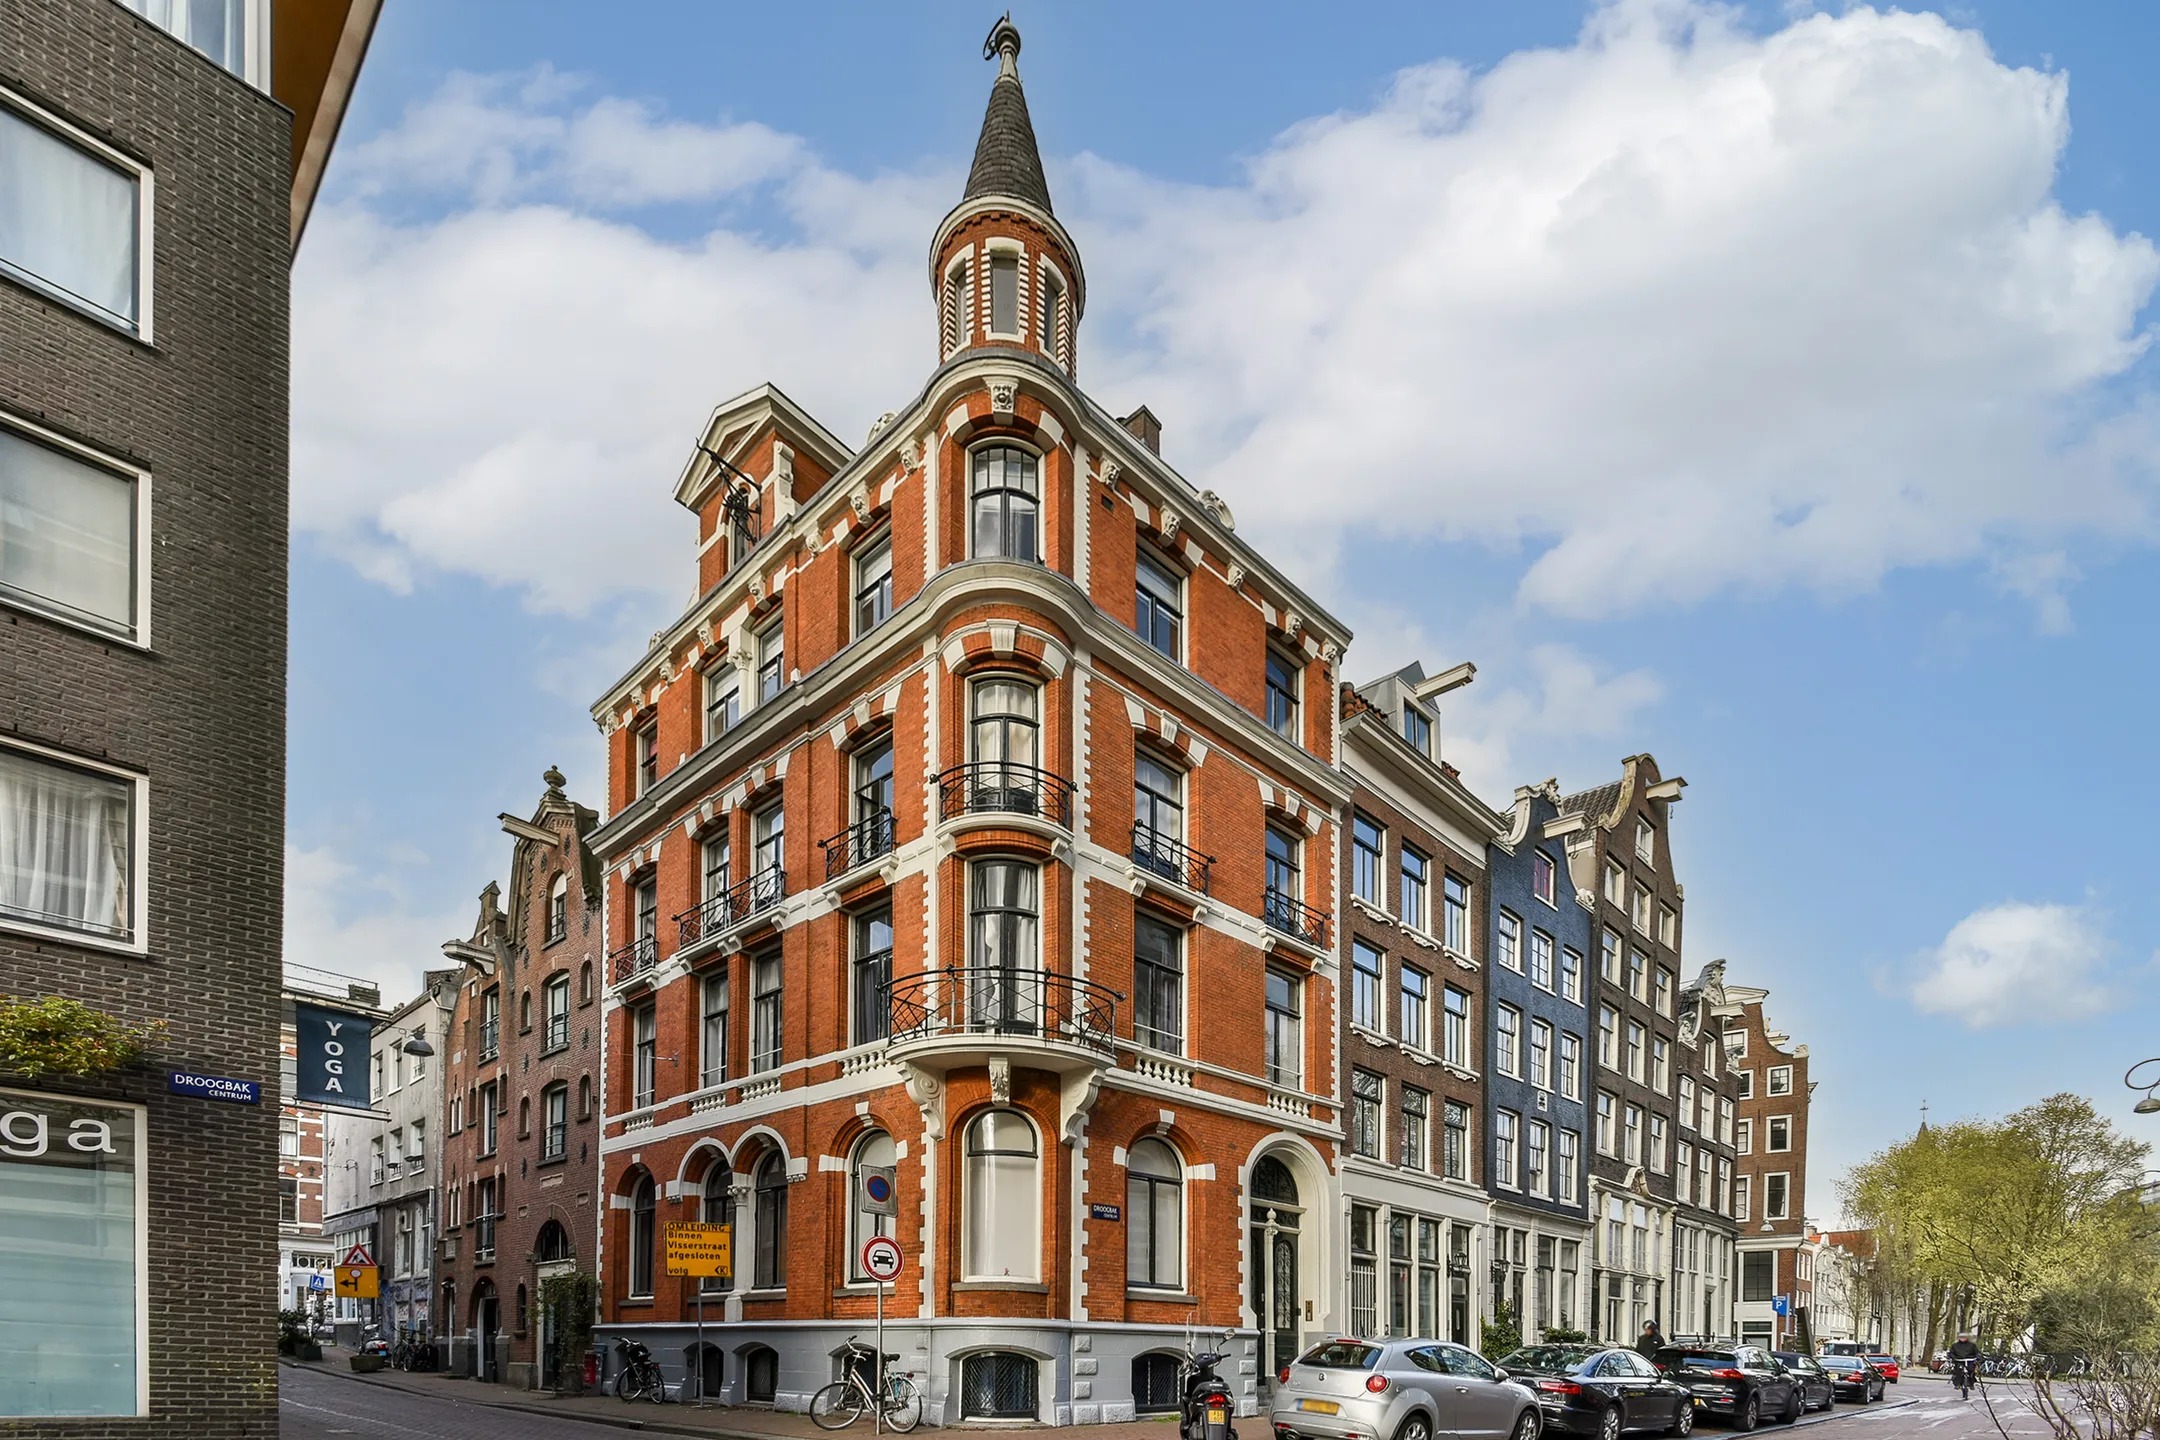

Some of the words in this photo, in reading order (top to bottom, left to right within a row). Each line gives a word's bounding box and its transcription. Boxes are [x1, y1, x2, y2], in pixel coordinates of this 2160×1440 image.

[324, 1020, 344, 1093] YOGA
[175, 1074, 251, 1093] DROOGBAK
[208, 1089, 252, 1101] CENTRUM
[668, 1222, 725, 1232] OMLEIDING
[668, 1231, 702, 1239] Binnen
[667, 1241, 727, 1250] Visserstraat
[668, 1251, 721, 1260] afgesloten
[668, 1267, 689, 1275] volg
